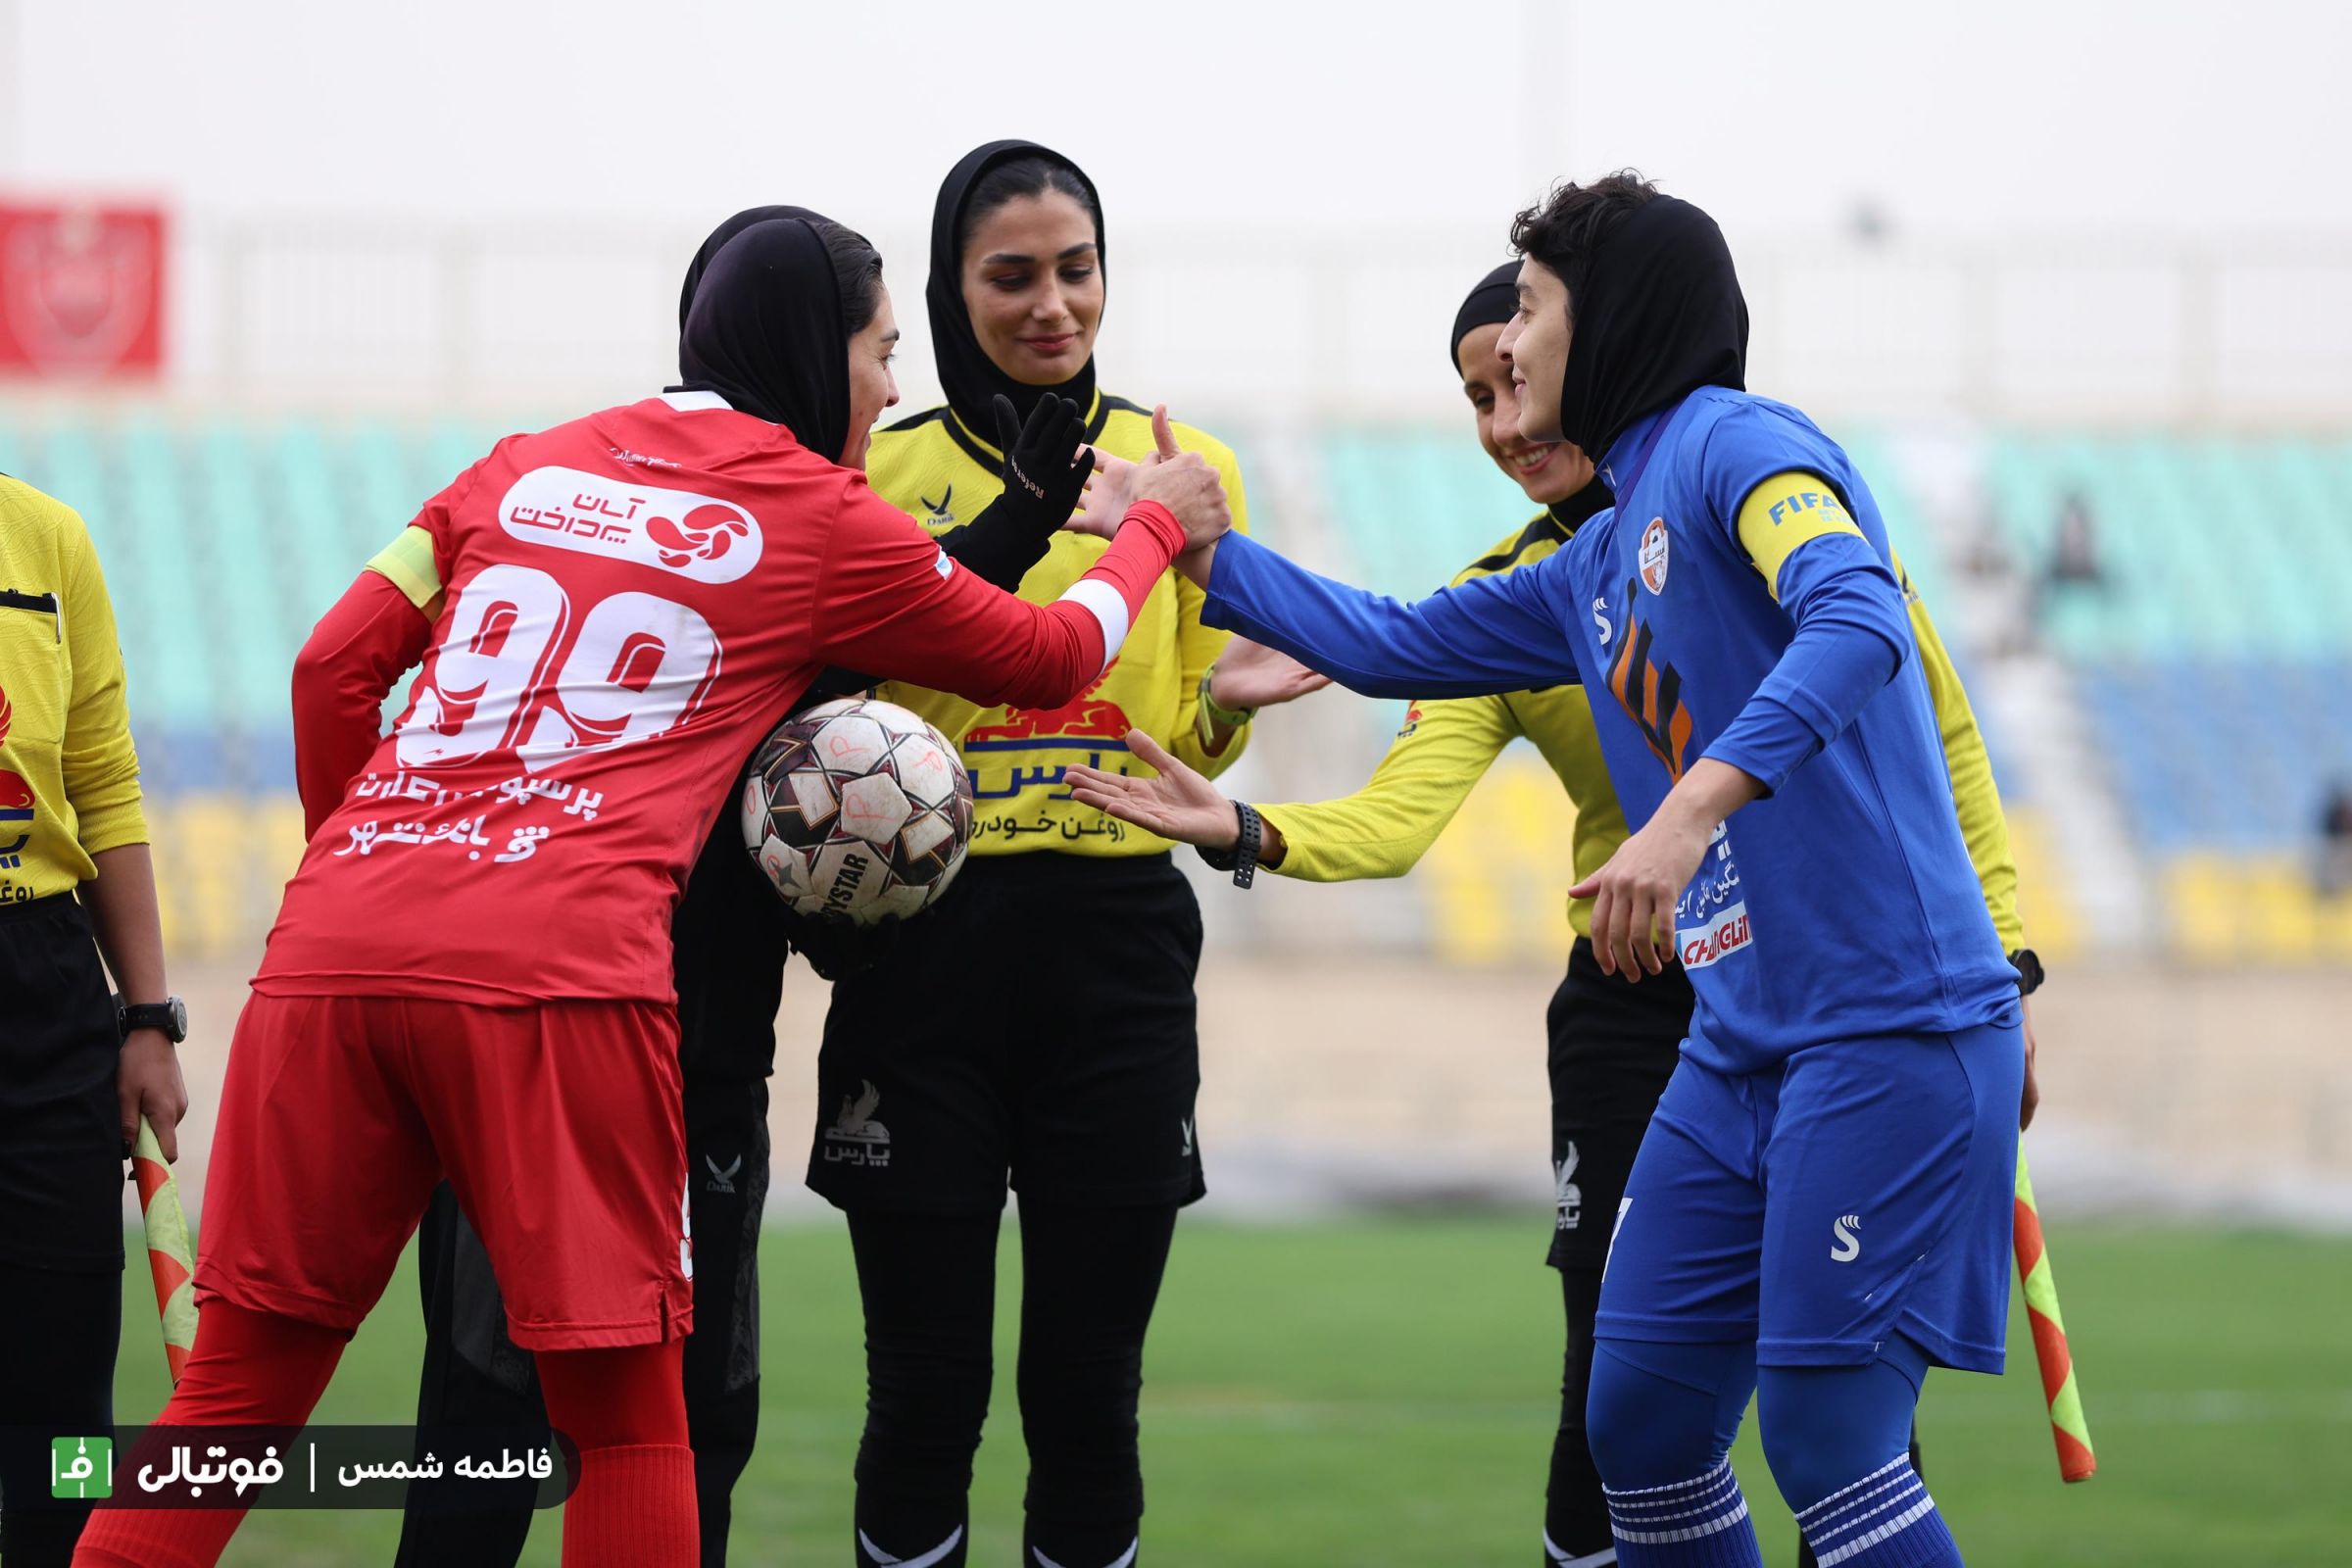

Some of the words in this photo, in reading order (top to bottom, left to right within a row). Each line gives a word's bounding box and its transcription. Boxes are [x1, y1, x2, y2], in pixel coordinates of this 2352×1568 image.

[510, 506, 632, 545] پرداخت
[1769, 492, 1842, 526] FIFA
[396, 564, 722, 773] 99
[434, 776, 604, 821] پرسپو
[1061, 812, 1126, 842] روغن
[0, 879, 34, 903] روغ
[824, 1144, 891, 1167] پارس
